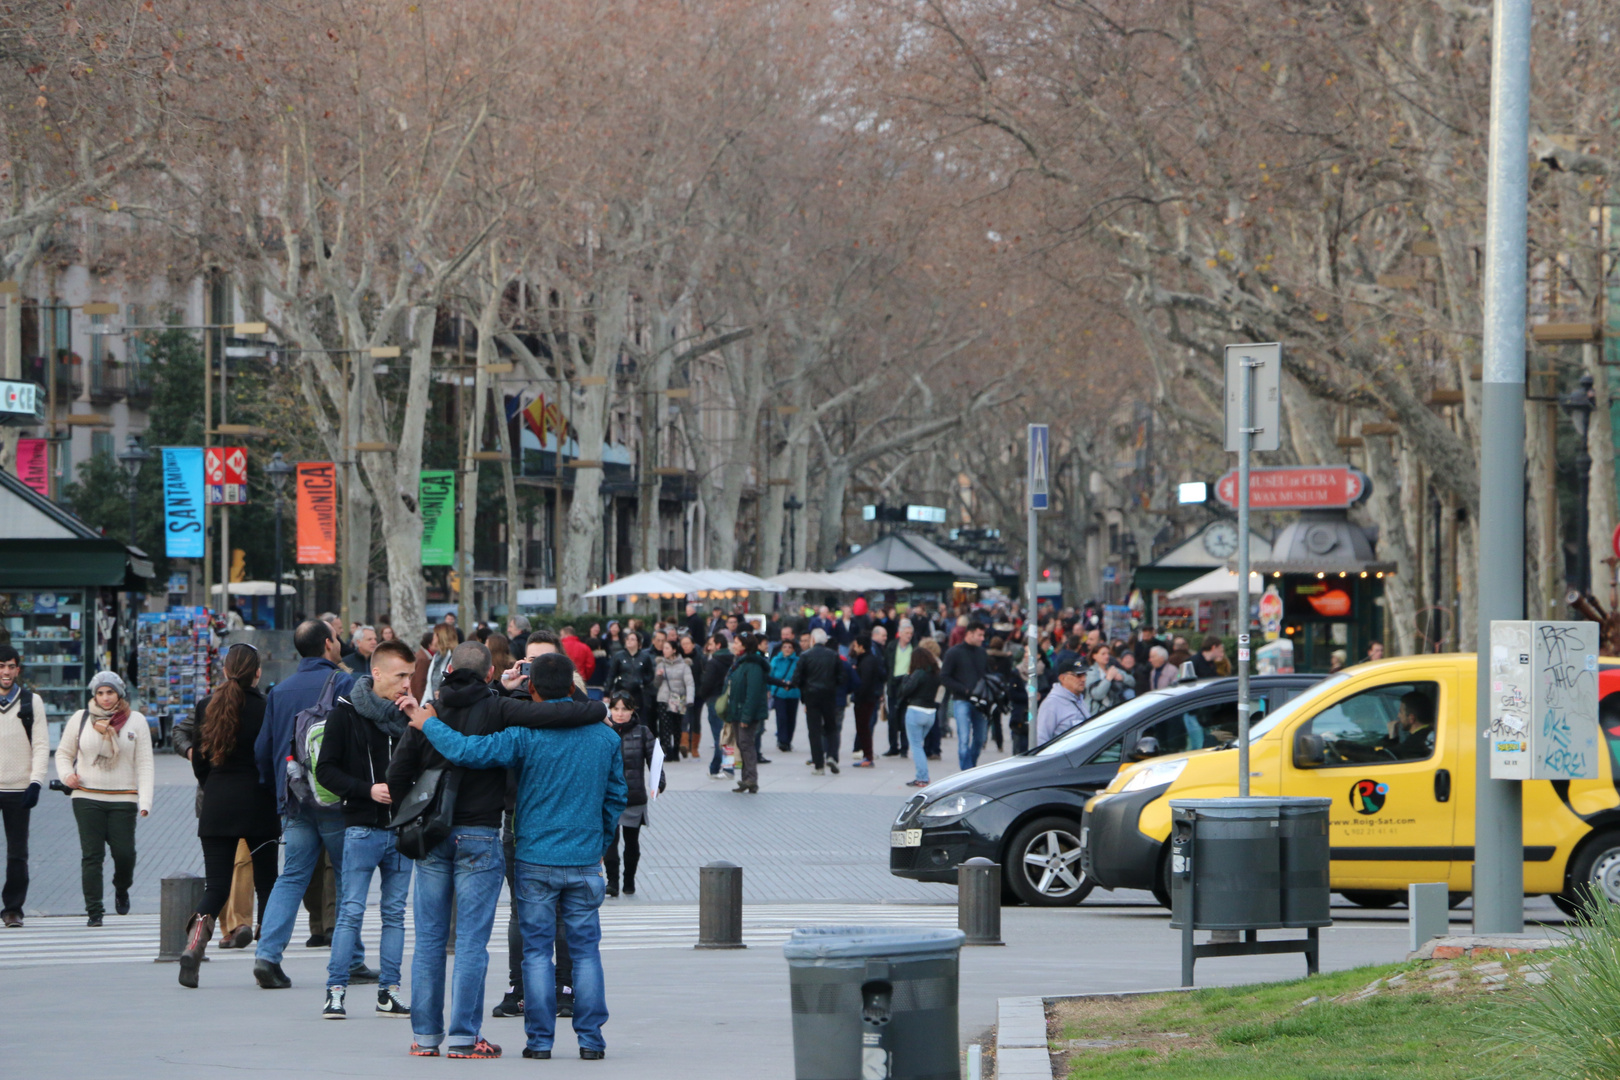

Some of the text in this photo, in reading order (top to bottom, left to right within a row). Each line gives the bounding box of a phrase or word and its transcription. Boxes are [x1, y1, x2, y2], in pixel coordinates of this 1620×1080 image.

[1302, 473, 1337, 486] CERA
[1253, 489, 1328, 502] WAX MUSEUM
